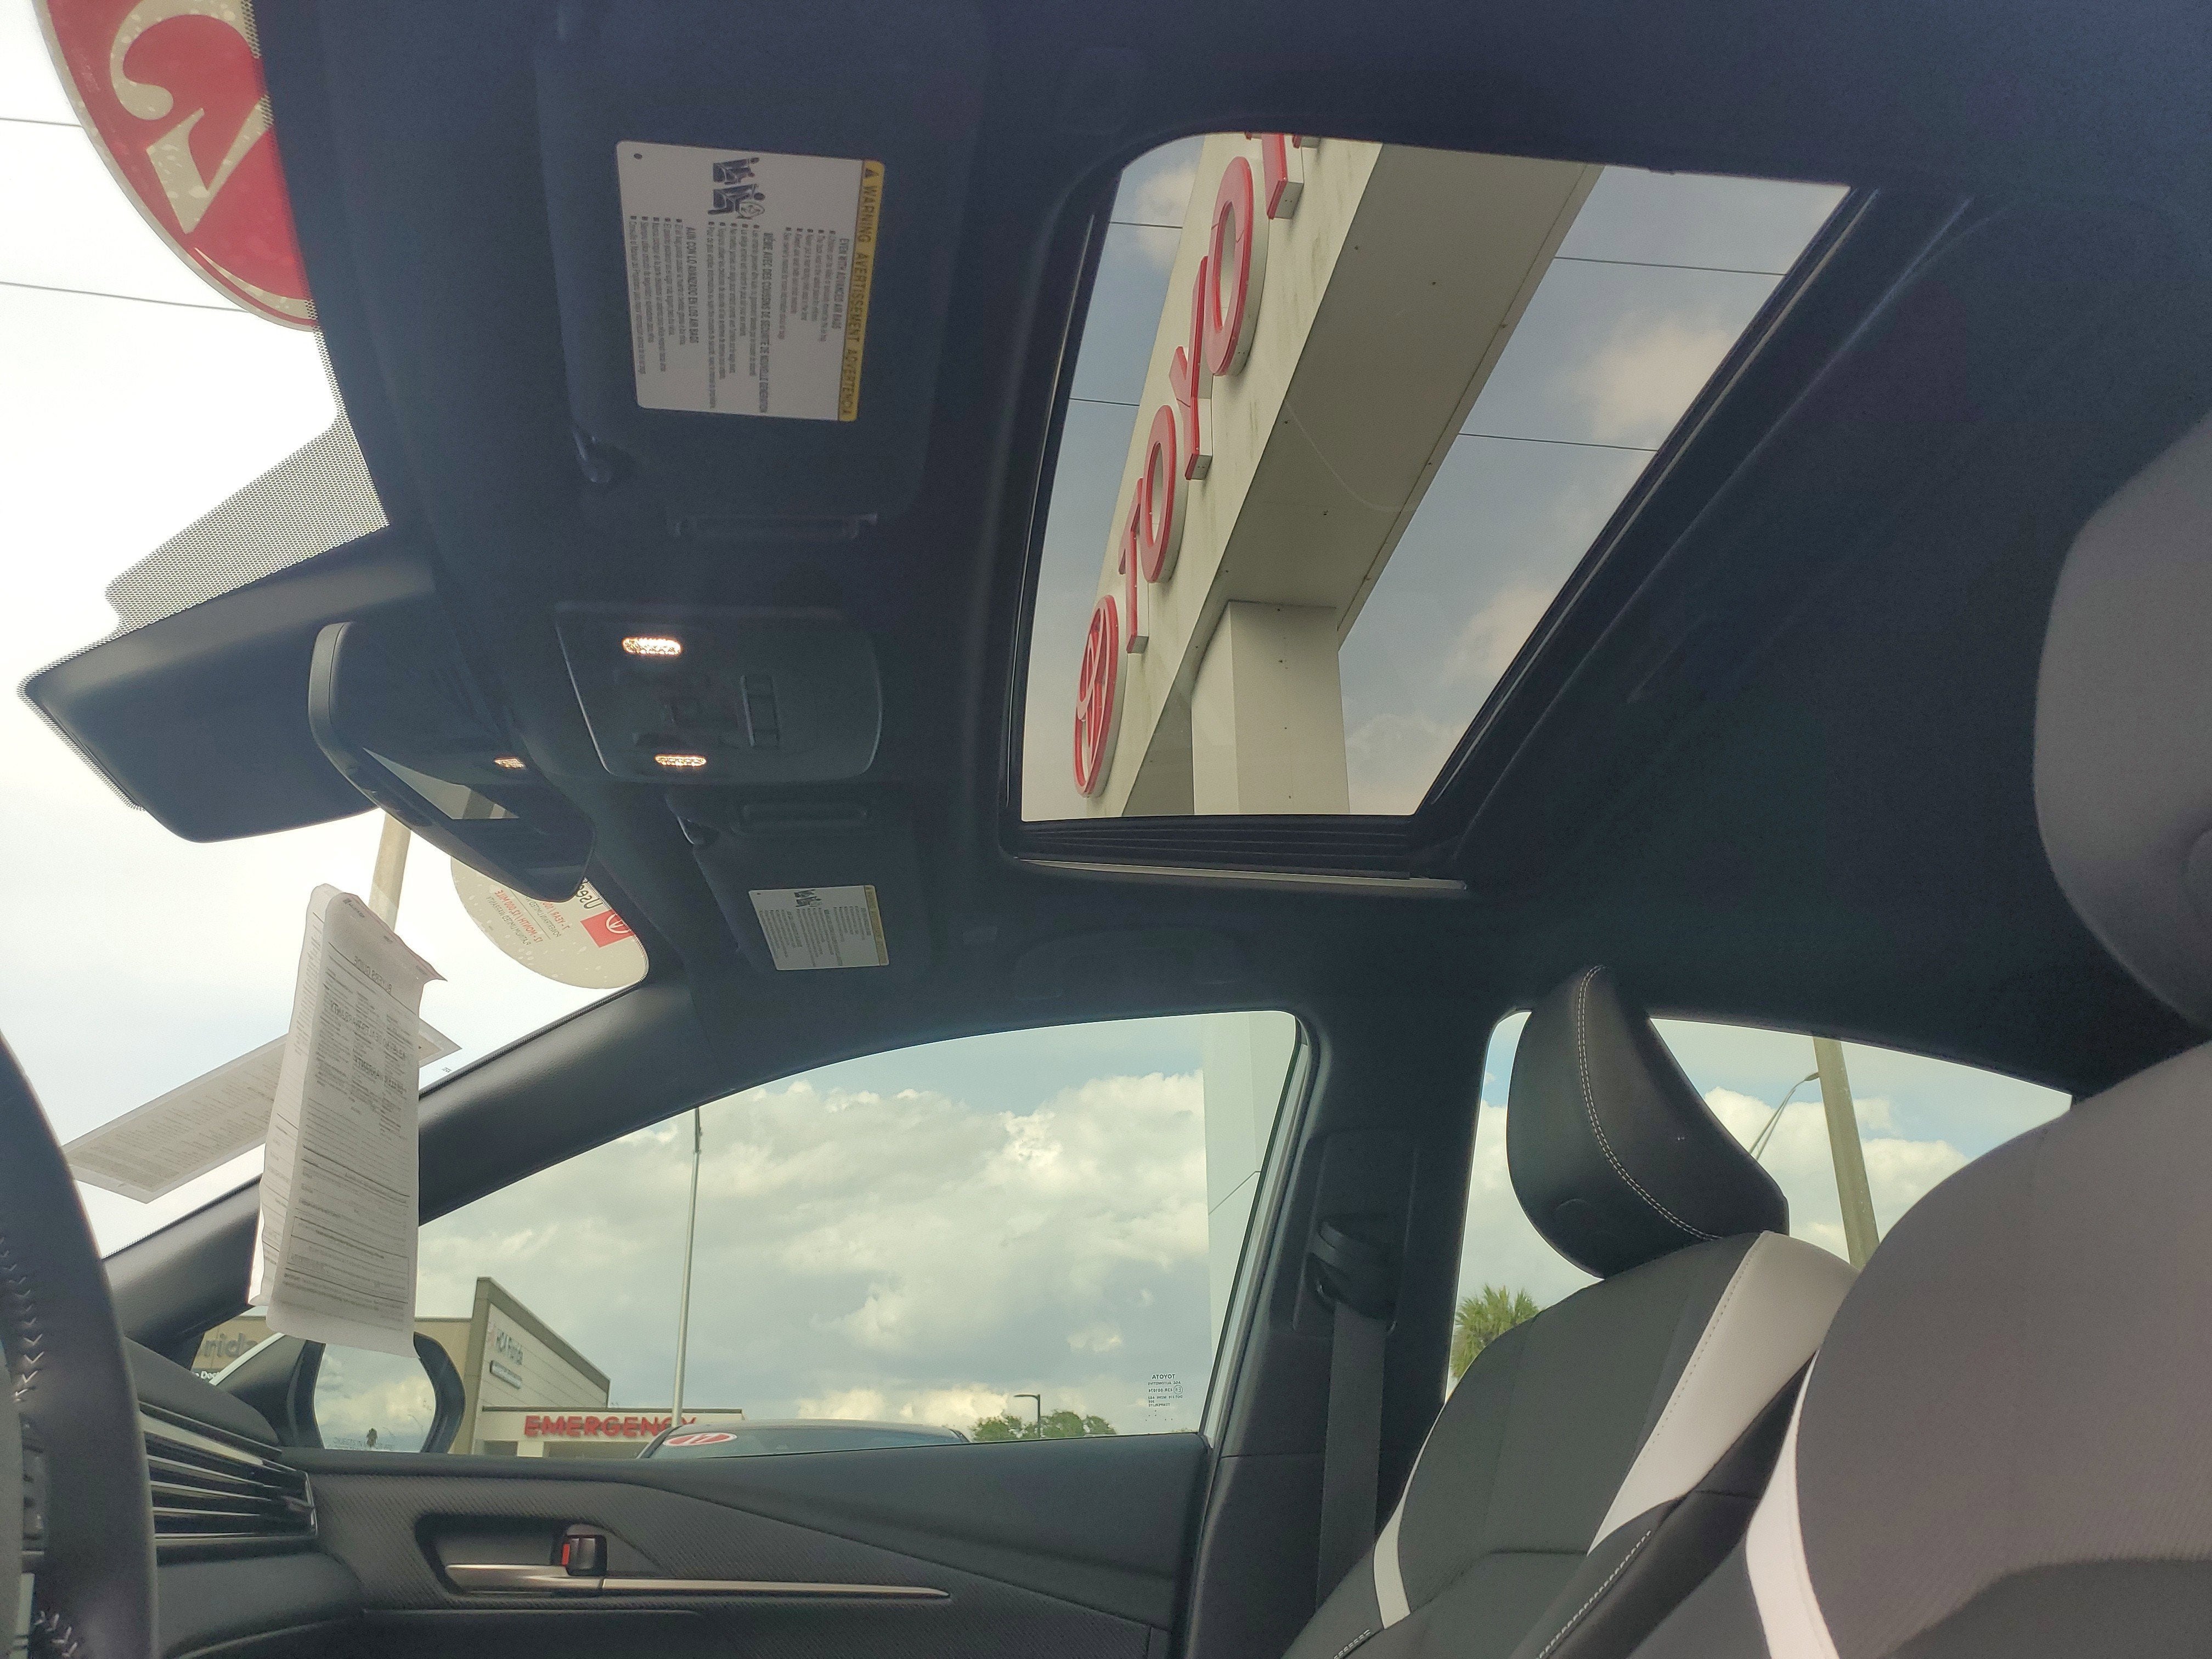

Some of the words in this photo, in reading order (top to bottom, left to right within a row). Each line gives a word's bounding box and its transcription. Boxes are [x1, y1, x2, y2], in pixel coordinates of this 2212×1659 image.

[857, 184, 877, 243] WARNING
[1119, 132, 1301, 654] TOYO
[204, 1333, 258, 1357] rid
